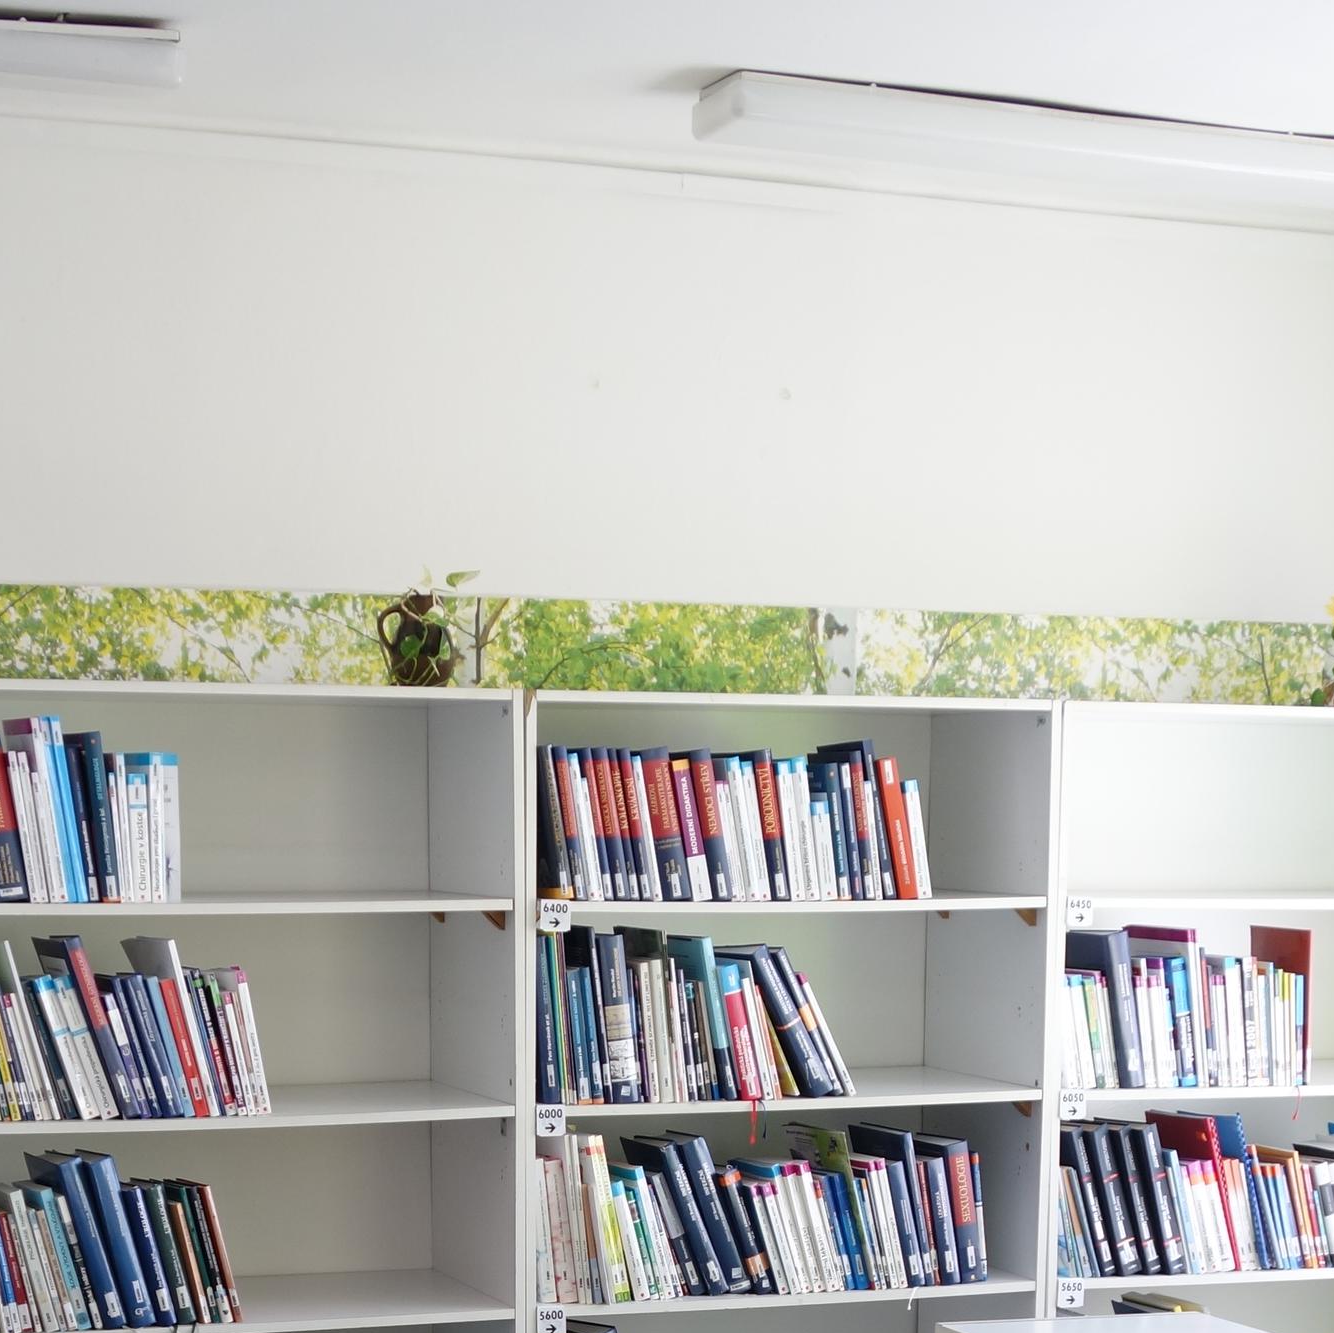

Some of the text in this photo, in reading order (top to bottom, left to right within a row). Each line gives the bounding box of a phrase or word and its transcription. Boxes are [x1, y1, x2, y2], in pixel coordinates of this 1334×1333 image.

[612, 769, 629, 830] KOLOSKOPIE
[626, 777, 639, 820] KRVÁCENÍ
[699, 763, 718, 834] NEMOCI STŘEV
[756, 767, 777, 833] PORODNICTVÍ
[136, 812, 144, 840] kostce
[680, 776, 699, 854] MODERNÍ DIDAKTIKA
[137, 851, 147, 891] Chirurgie
[543, 903, 568, 914] 6400
[1070, 900, 1092, 909] 6450
[1245, 1020, 1256, 1047] 2007
[1062, 1093, 1084, 1102] 6050
[538, 1108, 563, 1119] 6000
[955, 1156, 972, 1222] SEXUOLOGIE
[1060, 1282, 1083, 1292] 5650
[539, 1310, 564, 1320] 5600
